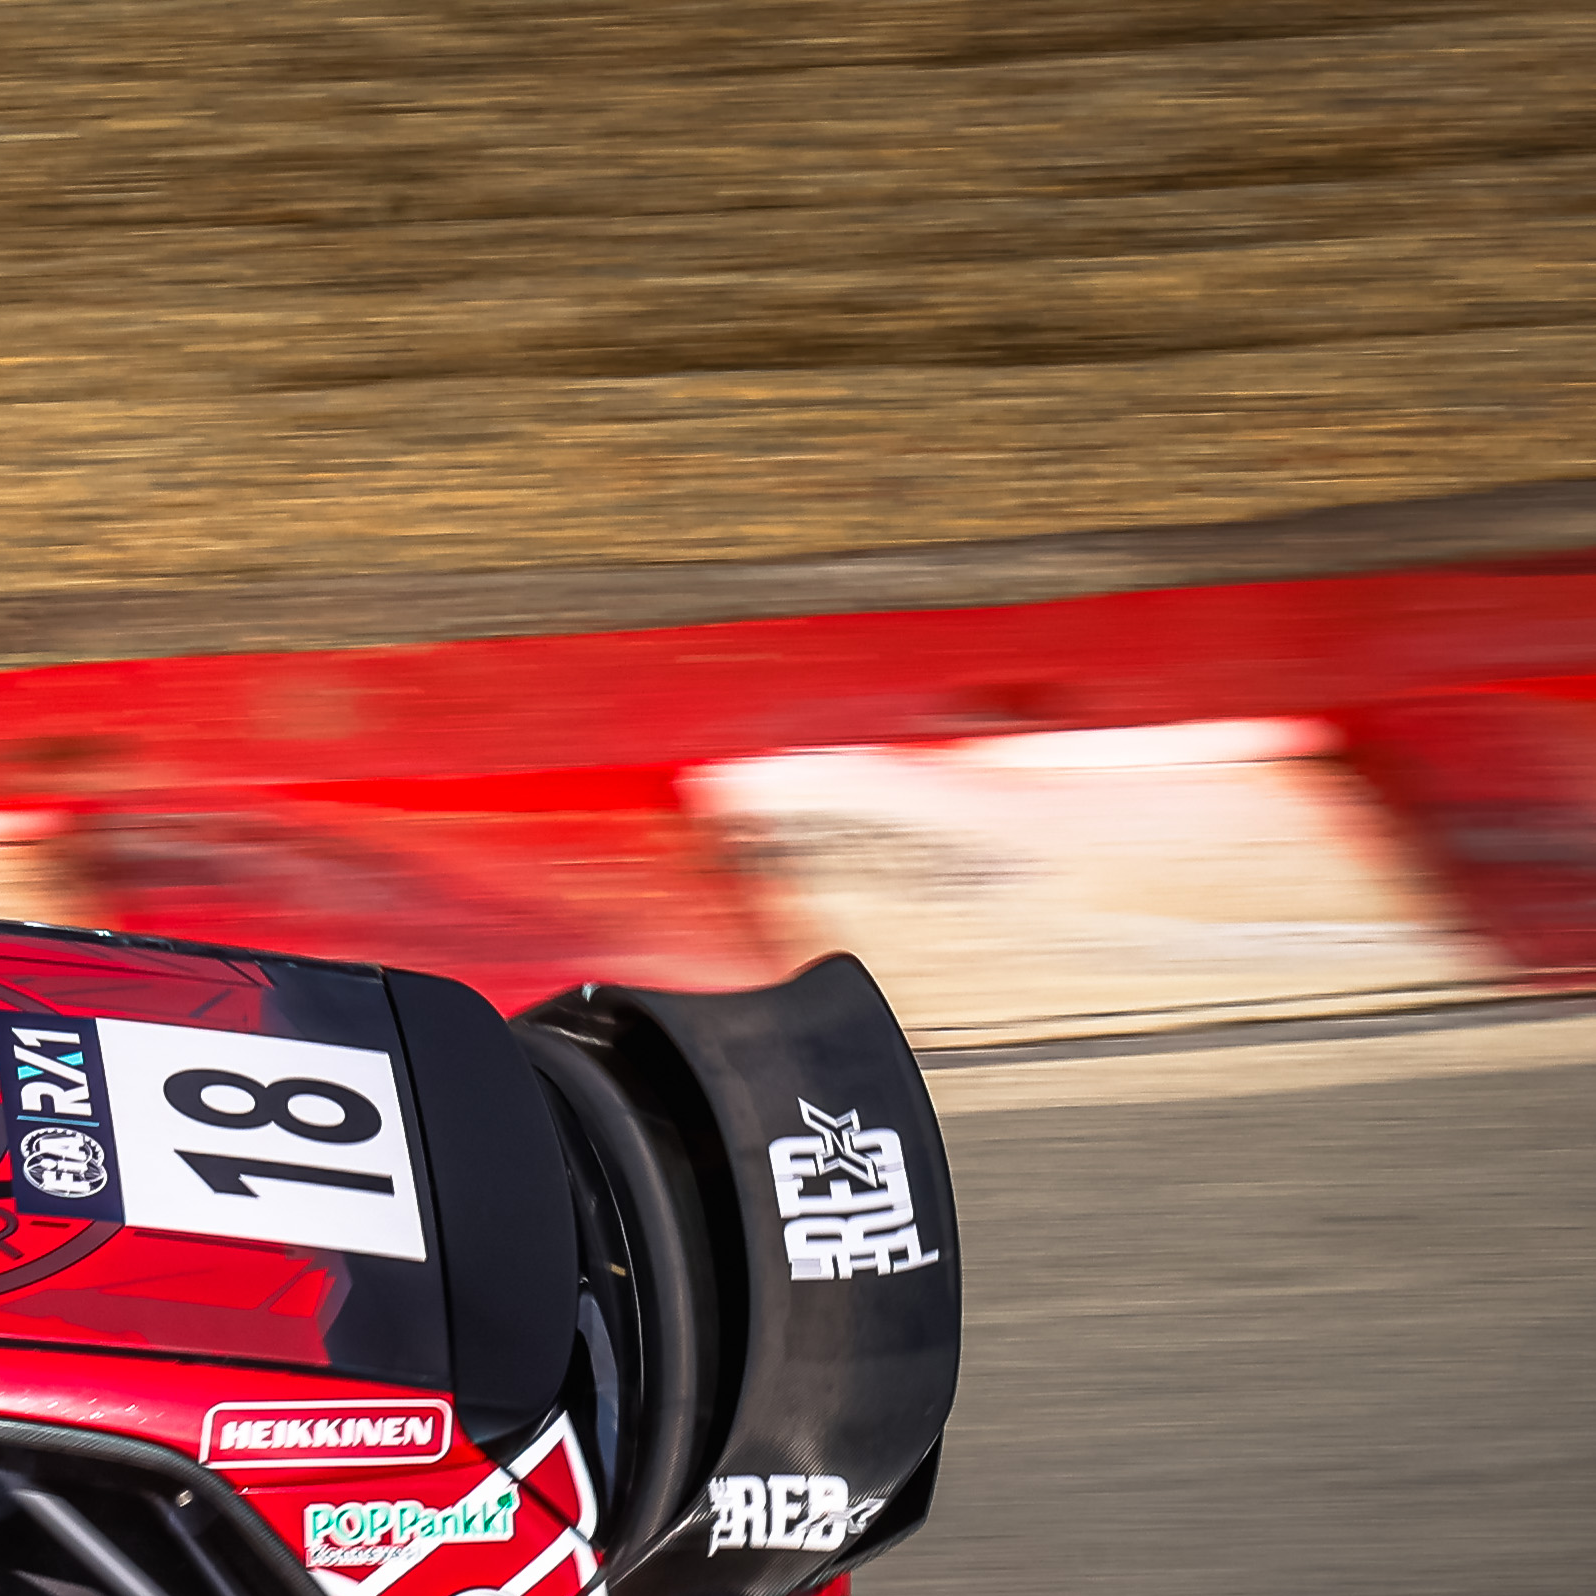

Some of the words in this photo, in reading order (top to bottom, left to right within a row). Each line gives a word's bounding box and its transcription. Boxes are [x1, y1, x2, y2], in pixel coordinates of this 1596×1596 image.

[11, 1026, 94, 1117] RX1
[163, 1067, 396, 1199] 18
[219, 1414, 435, 1451] HEIKKINEN
